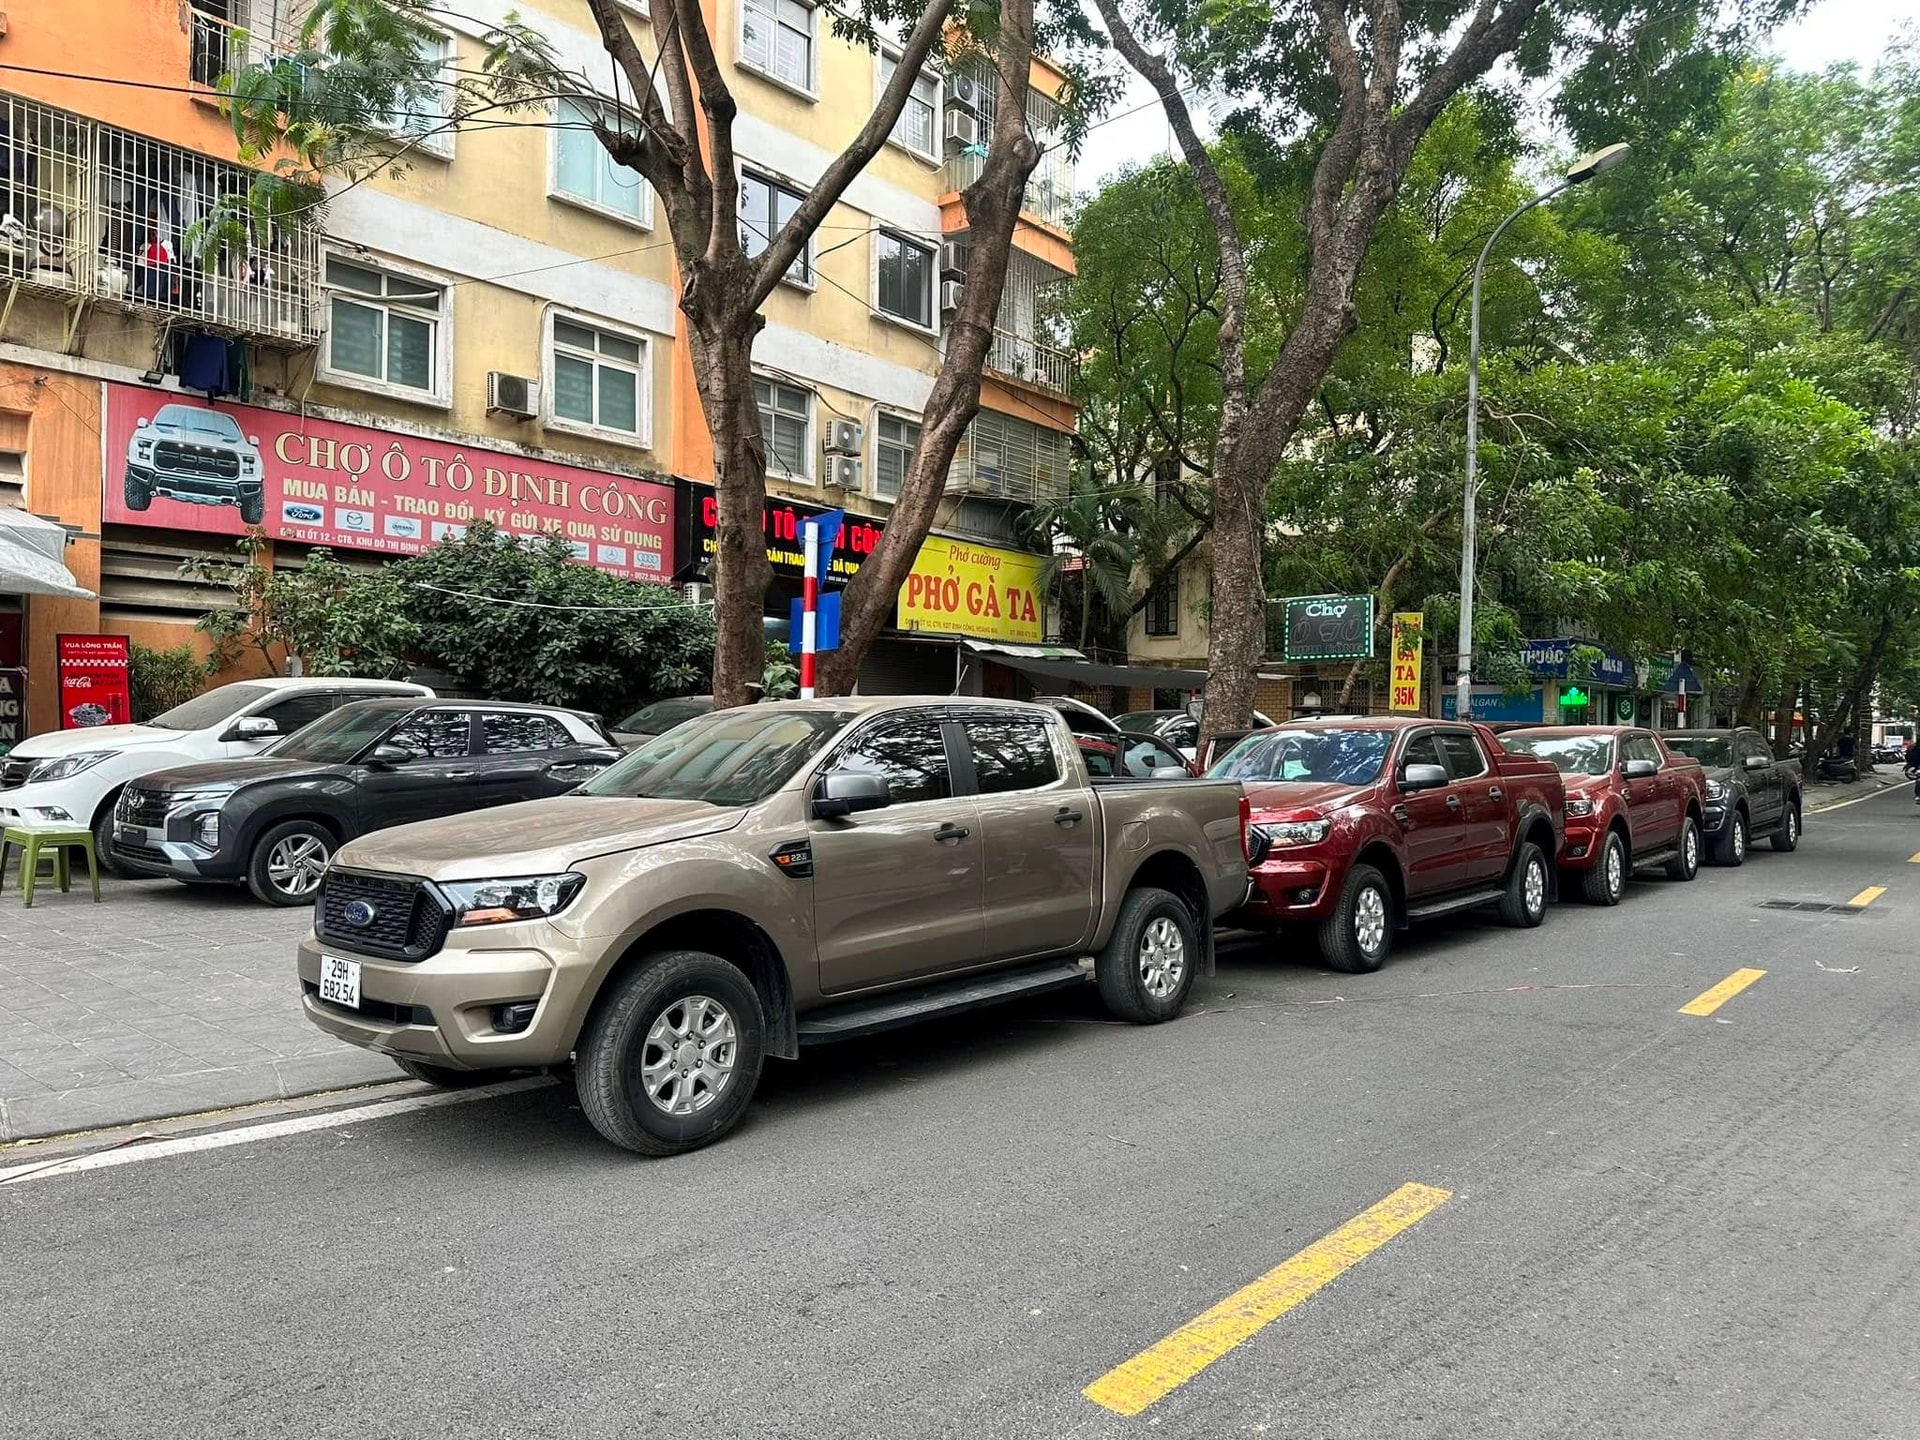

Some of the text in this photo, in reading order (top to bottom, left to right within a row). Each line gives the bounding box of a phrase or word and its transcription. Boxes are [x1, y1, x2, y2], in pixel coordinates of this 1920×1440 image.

[274, 431, 372, 483] CHỢ
[380, 441, 411, 481] Ô
[420, 453, 474, 492] TÔ
[483, 467, 571, 508] ĐỊNH
[579, 481, 668, 525] CÔNG
[282, 478, 329, 501] MUA
[334, 484, 375, 508] BÁN
[393, 494, 440, 517] TRAO
[542, 516, 562, 534] XE
[567, 520, 597, 541] QUA
[601, 522, 622, 544] SỬ
[624, 530, 663, 550] DỤNG
[290, 508, 316, 520] Ford
[772, 506, 796, 541] TÔ
[356, 537, 373, 547] KHU
[906, 564, 1037, 623] PHỞ GÀ TA
[1305, 602, 1348, 618] Chợ
[1394, 665, 1416, 682] TA
[1394, 686, 1416, 706] 35K
[331, 959, 349, 982] 29H
[323, 978, 355, 1003] 682.54
